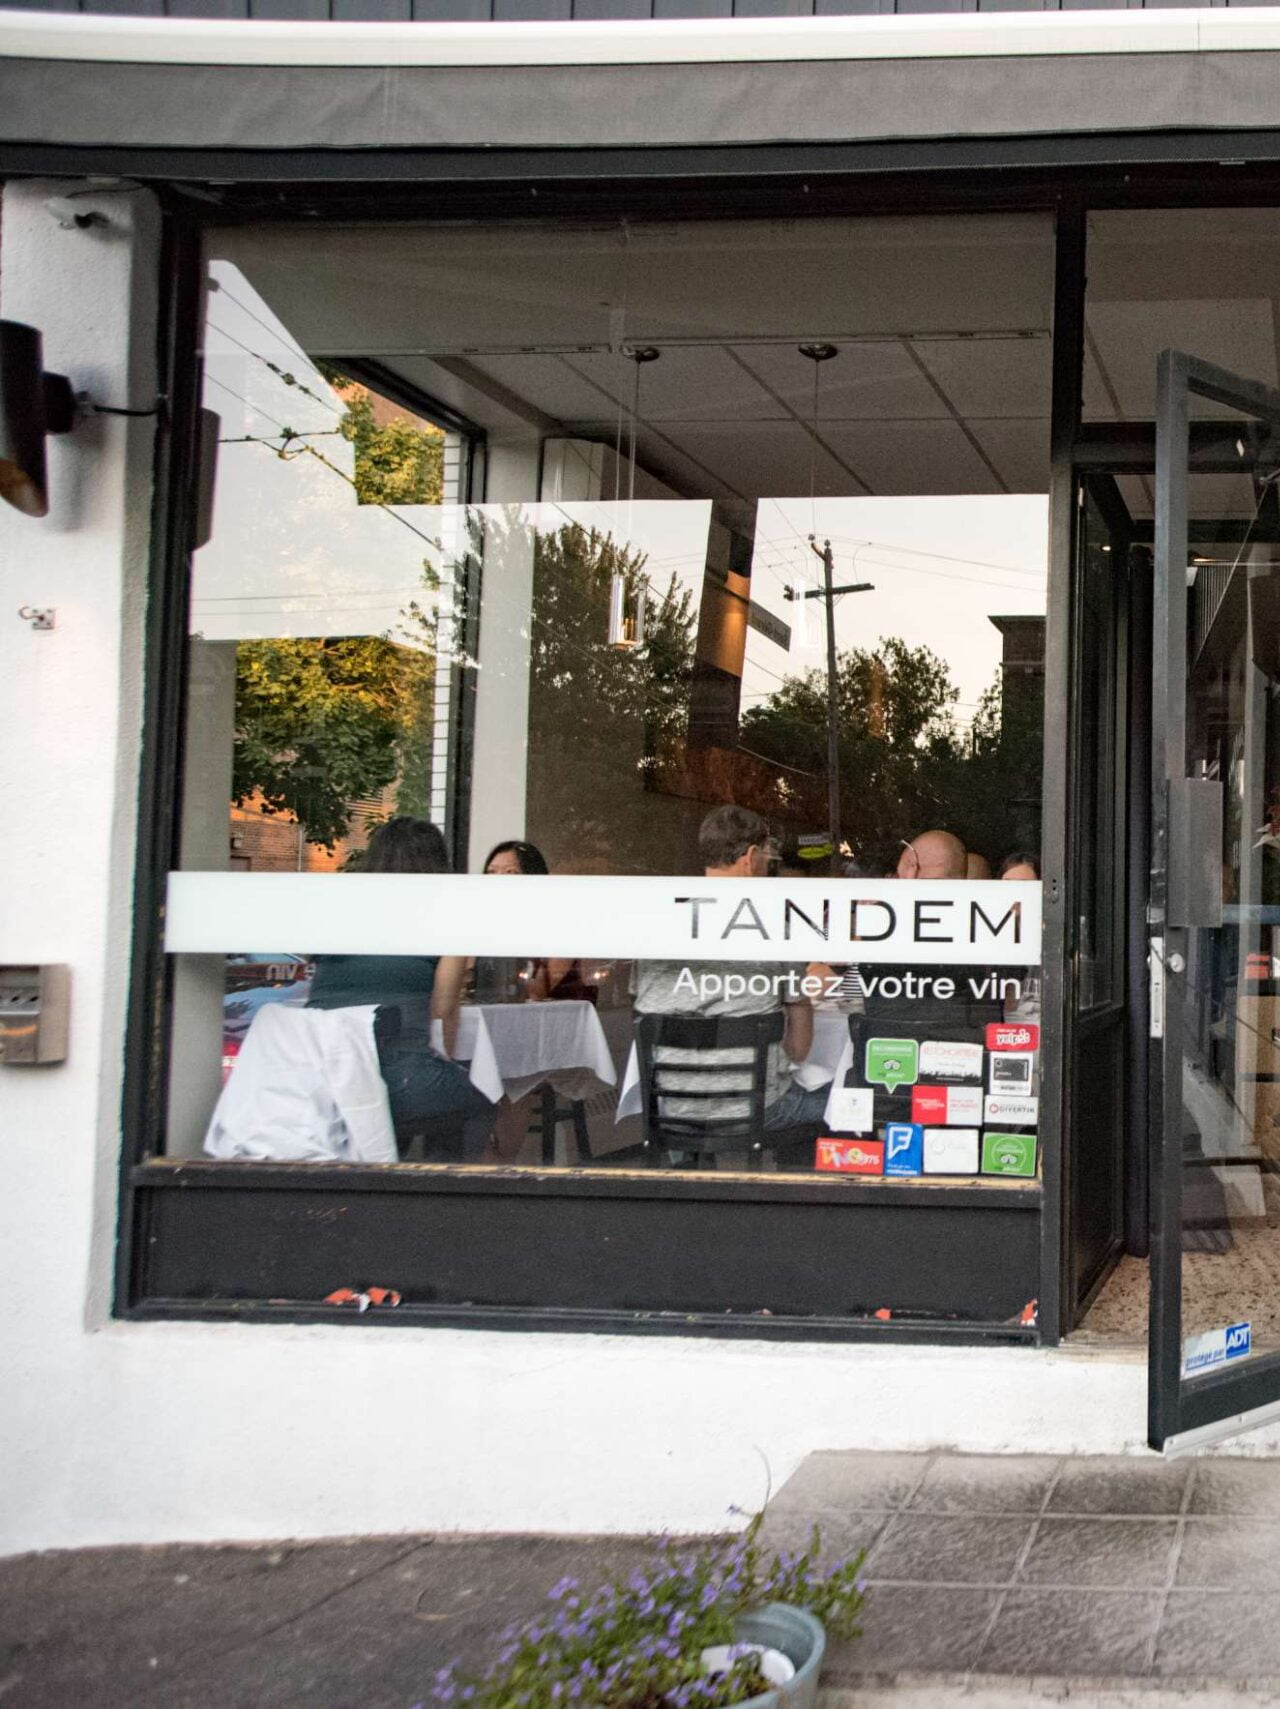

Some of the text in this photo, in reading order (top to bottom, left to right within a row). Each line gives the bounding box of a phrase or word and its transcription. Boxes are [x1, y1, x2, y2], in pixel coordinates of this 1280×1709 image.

[674, 896, 1022, 944] TANDEM
[672, 967, 1021, 1001] Apportez votre vin
[1227, 1326, 1250, 1350] ADT
